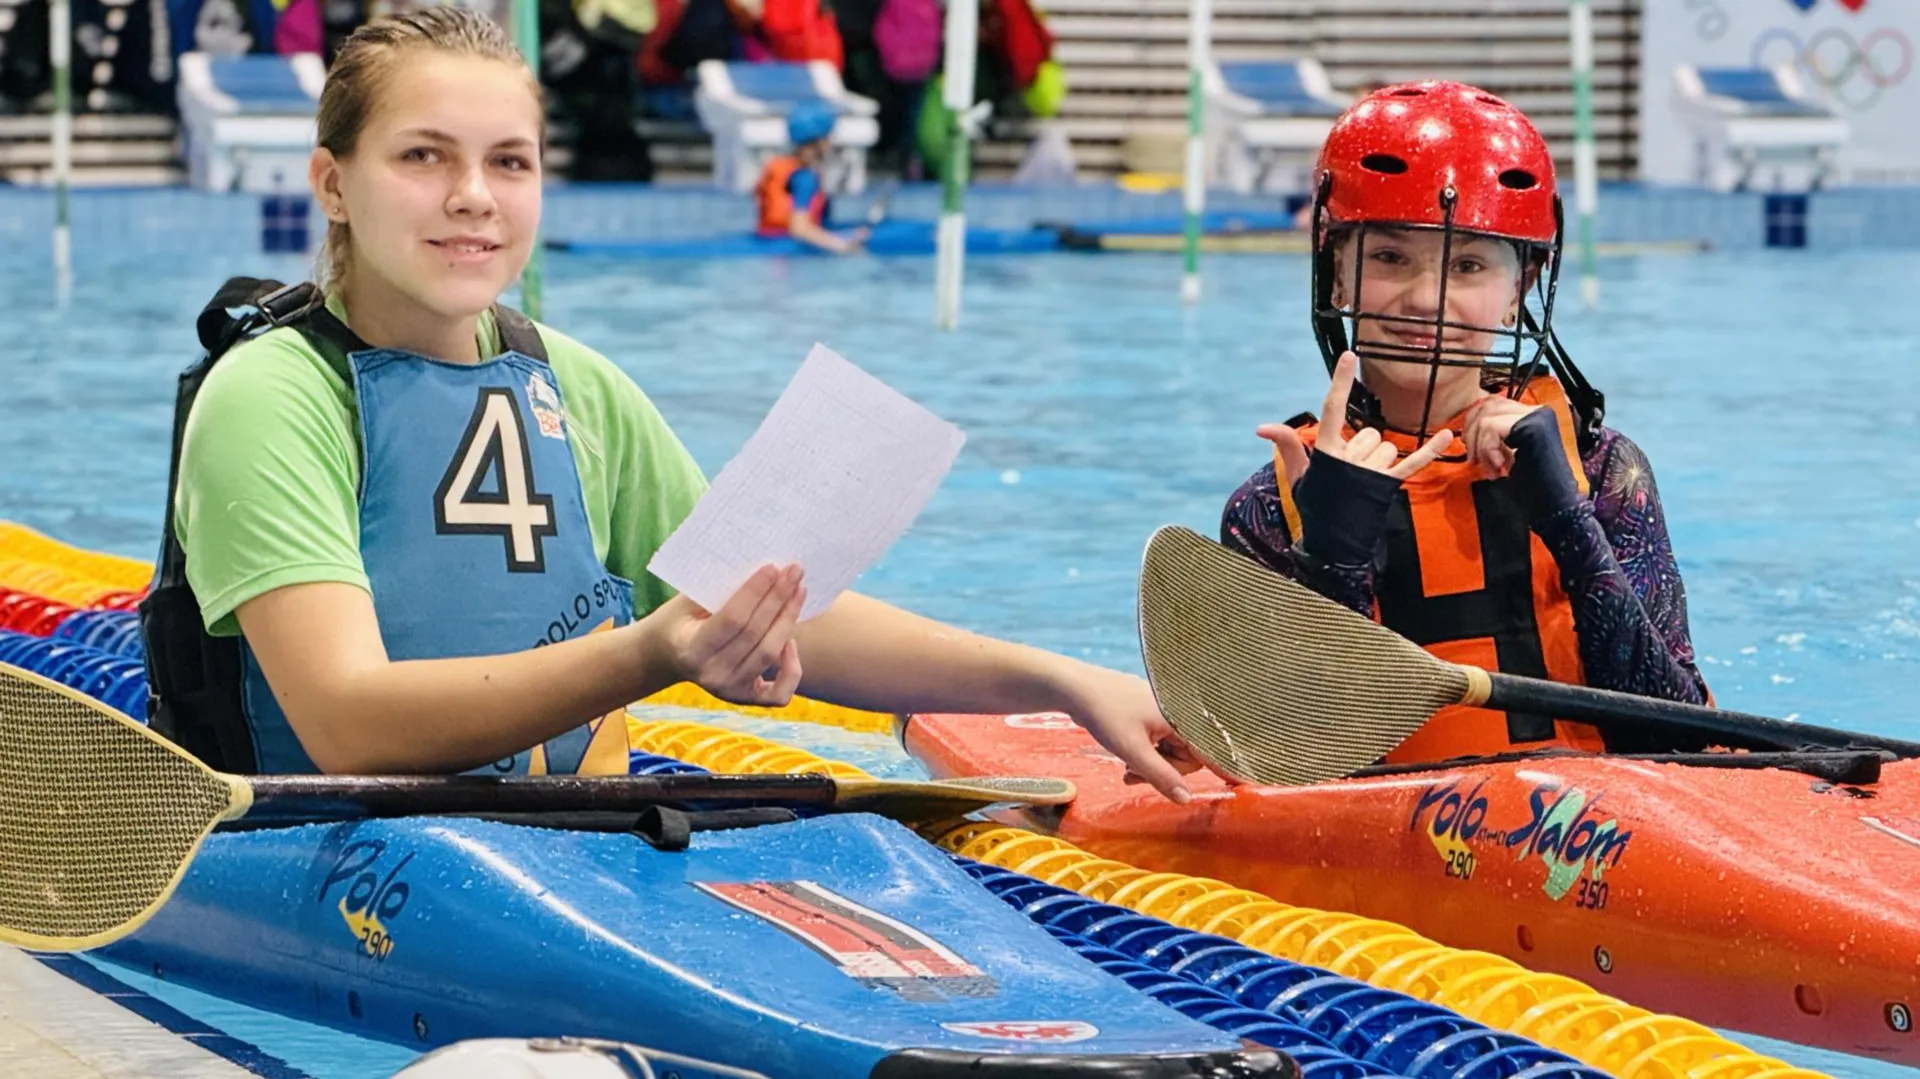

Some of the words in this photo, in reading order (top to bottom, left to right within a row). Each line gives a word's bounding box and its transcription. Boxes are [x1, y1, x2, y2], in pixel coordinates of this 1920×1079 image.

[433, 386, 558, 573] 4
[1505, 783, 1633, 867] Slalom
[318, 839, 416, 921] Polo
[1445, 849, 1475, 880] 290
[1576, 877, 1610, 910] 350
[356, 926, 394, 963] 290
